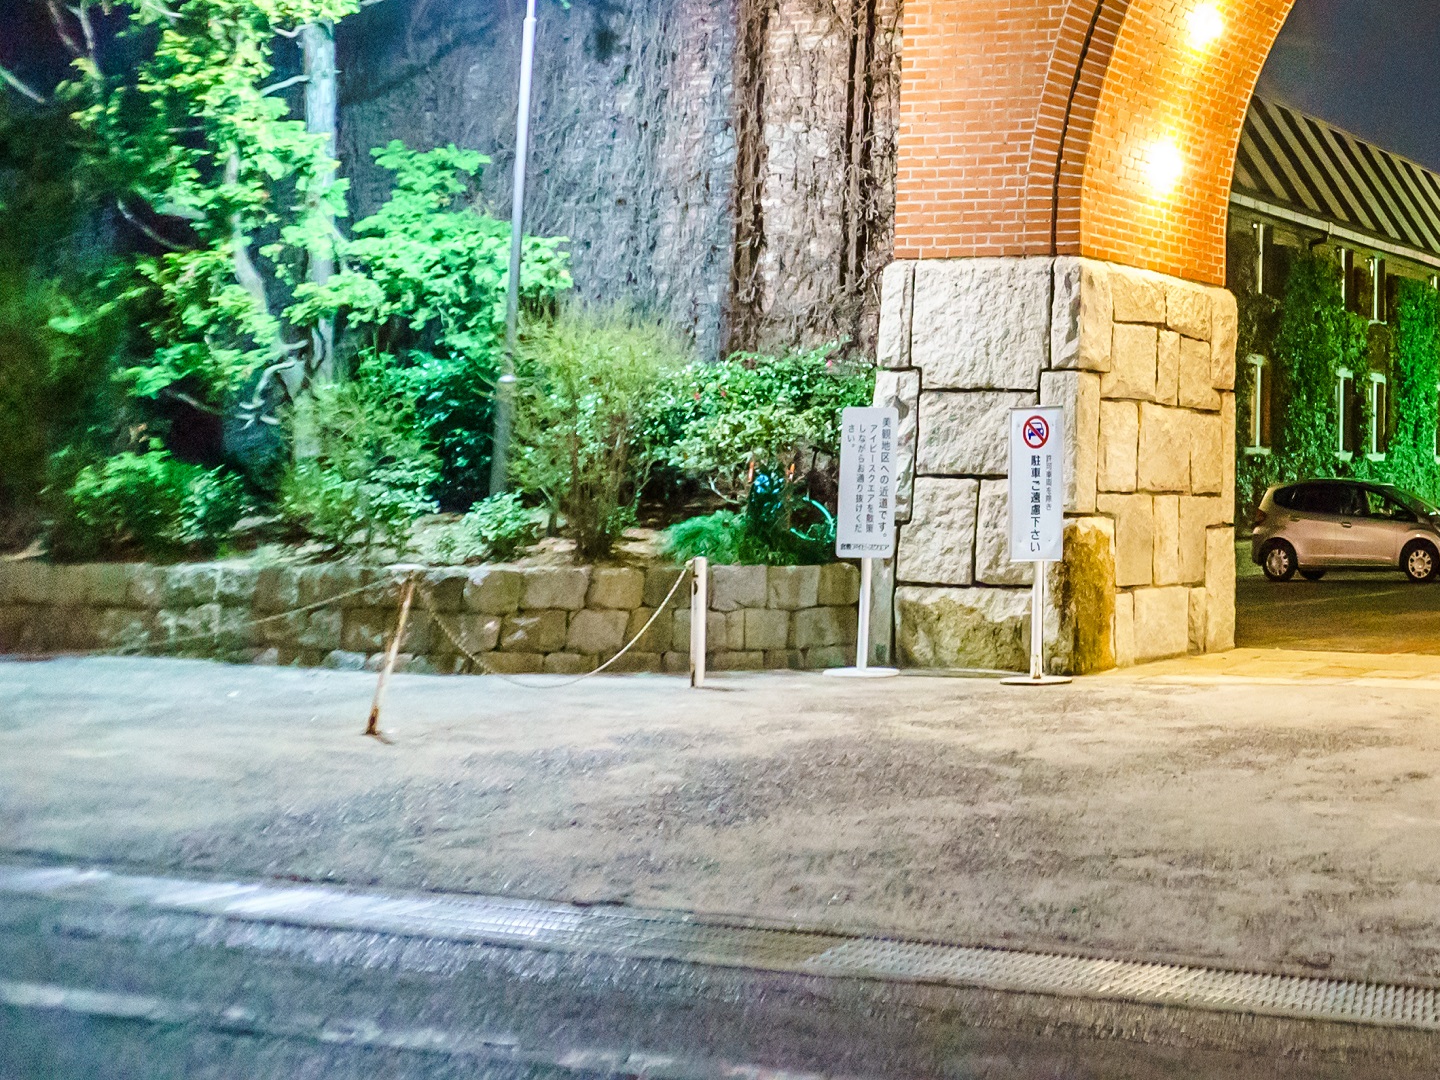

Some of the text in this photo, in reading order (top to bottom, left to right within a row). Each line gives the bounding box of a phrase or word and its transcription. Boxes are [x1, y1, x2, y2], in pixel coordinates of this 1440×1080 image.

[1030, 454, 1041, 552] 駐車ご遠慮下さい
